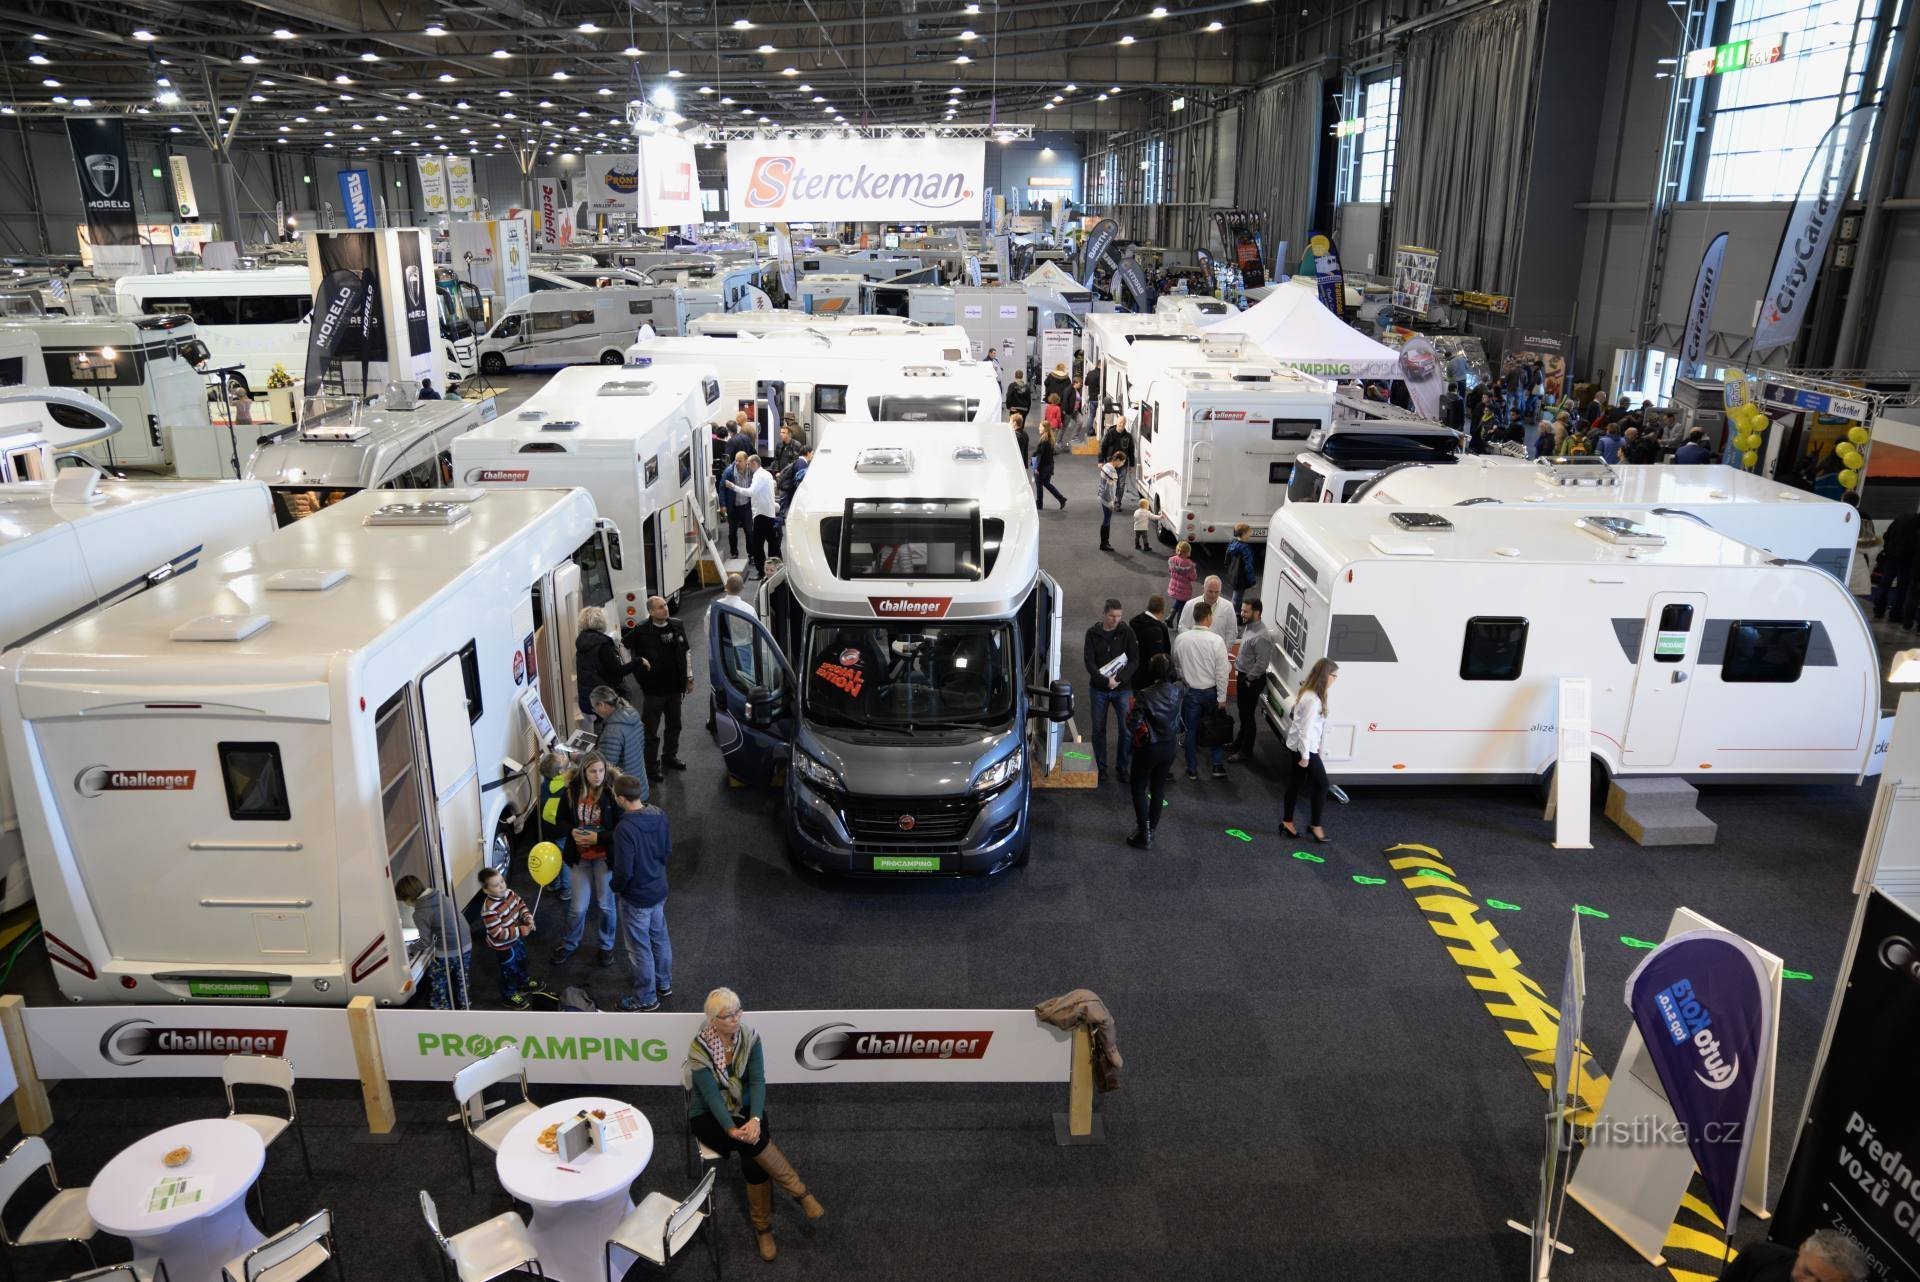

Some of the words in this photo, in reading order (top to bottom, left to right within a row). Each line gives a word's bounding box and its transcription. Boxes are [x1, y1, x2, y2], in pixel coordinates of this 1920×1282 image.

[88, 200, 130, 208] MORELO
[543, 185, 556, 244] Dethleffs
[1088, 231, 1109, 259] BARTH
[316, 286, 351, 347] MORELO
[362, 284, 374, 338] MORELO
[1833, 401, 1860, 417] YachtNet
[484, 471, 526, 482] Challenger
[879, 599, 941, 615] Challenger
[112, 772, 190, 790] Challenger
[158, 1031, 277, 1054] Challenger
[856, 1034, 980, 1060] Challenger
[1839, 1145, 1891, 1208] vozů
